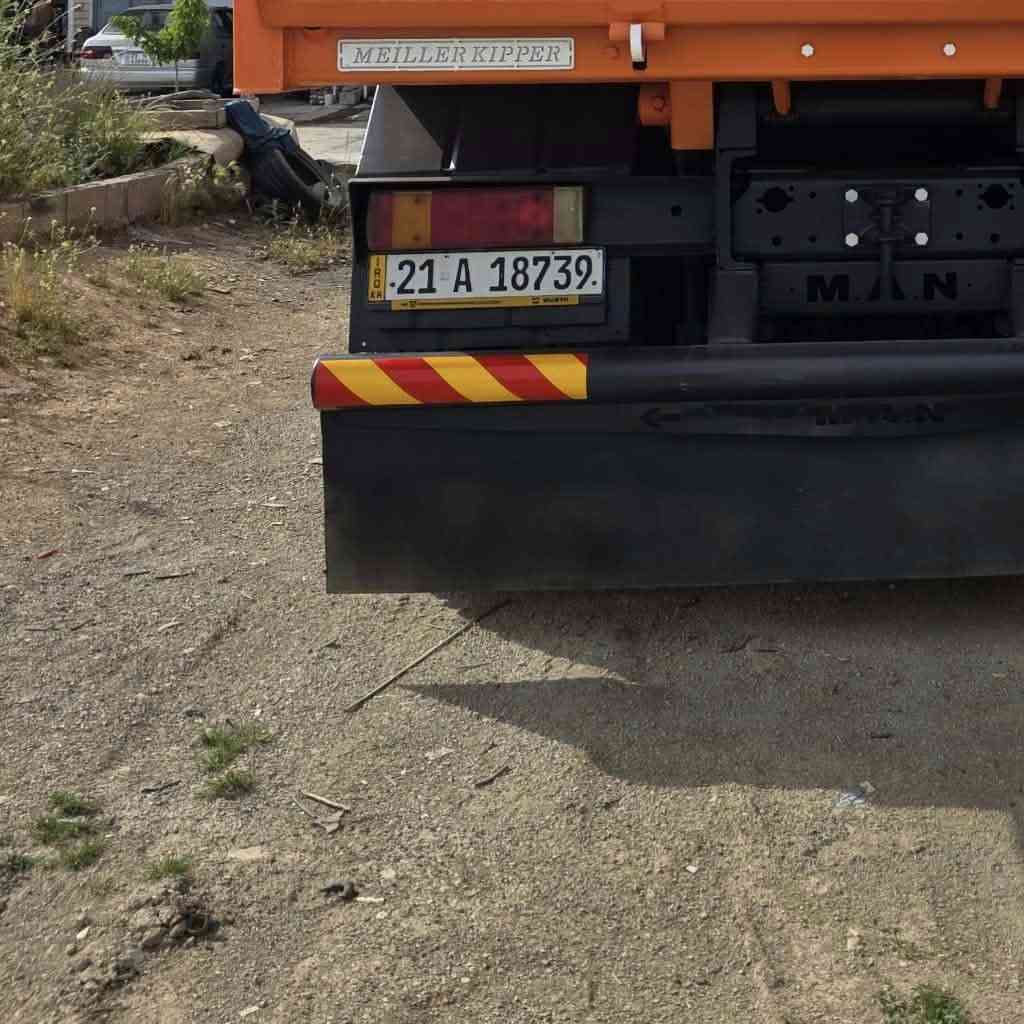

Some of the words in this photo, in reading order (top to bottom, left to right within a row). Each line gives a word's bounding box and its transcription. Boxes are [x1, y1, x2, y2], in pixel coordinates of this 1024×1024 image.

[352, 45, 466, 65] MEILLER
[472, 44, 561, 64] KIPPER
[397, 258, 437, 295] 21
[453, 257, 473, 293] A
[489, 254, 593, 292] 18739
